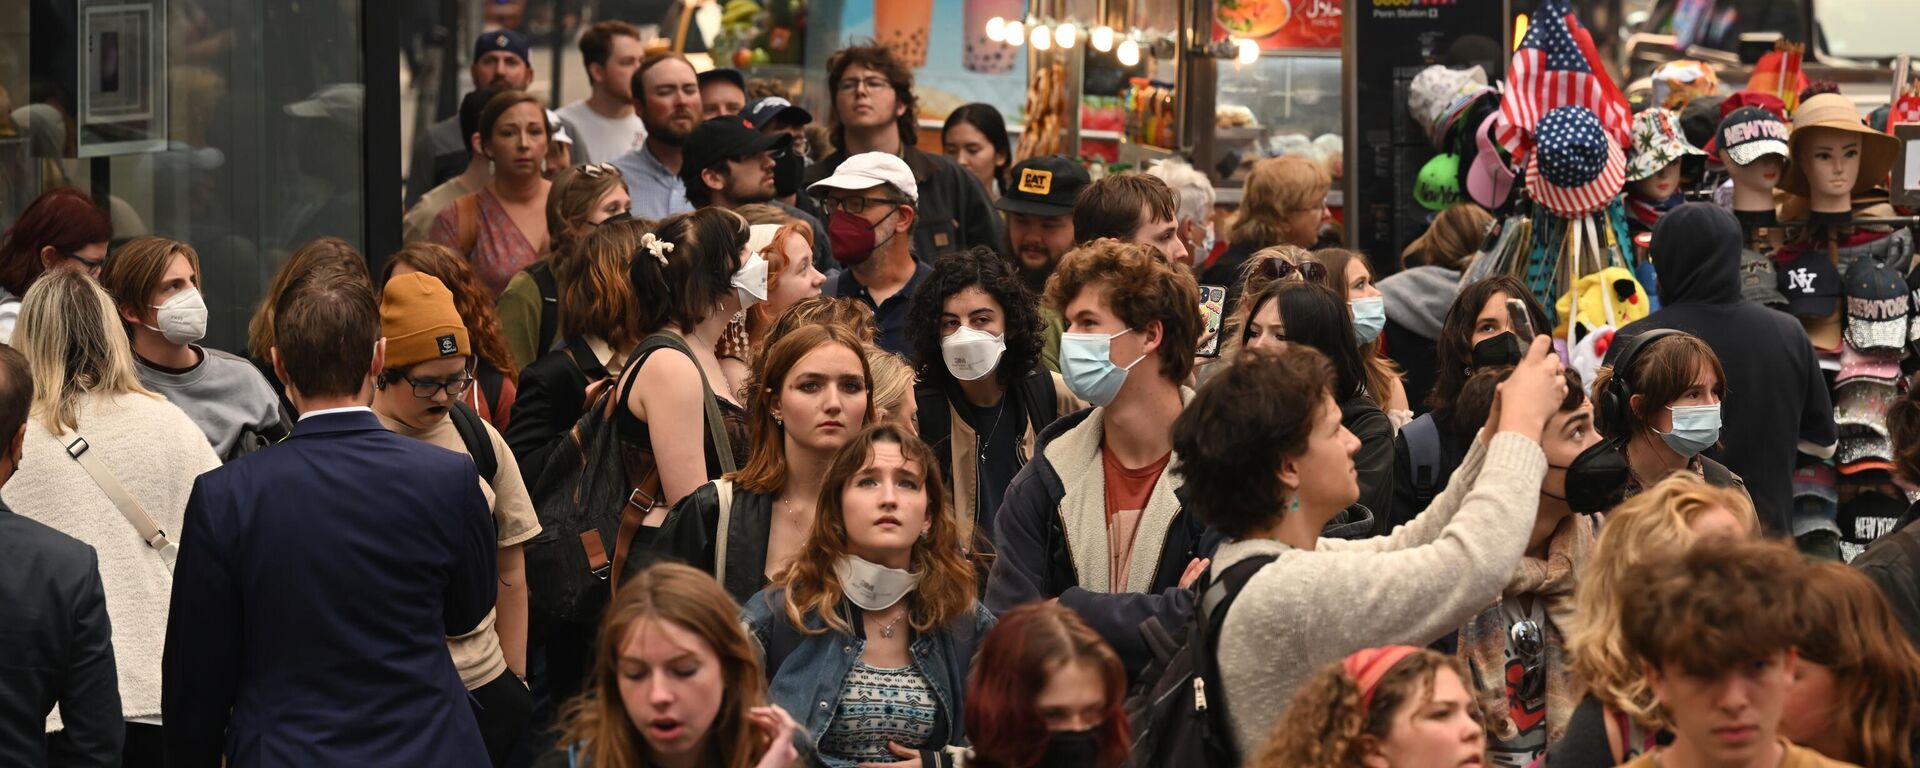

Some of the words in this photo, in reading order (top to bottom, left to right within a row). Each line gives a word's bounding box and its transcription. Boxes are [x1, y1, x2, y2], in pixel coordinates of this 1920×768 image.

[1373, 9, 1395, 18] Penn
[1397, 8, 1427, 18] Station
[1025, 173, 1047, 185] CAT
[1787, 267, 1818, 293] NY
[1855, 516, 1877, 539] NEW
